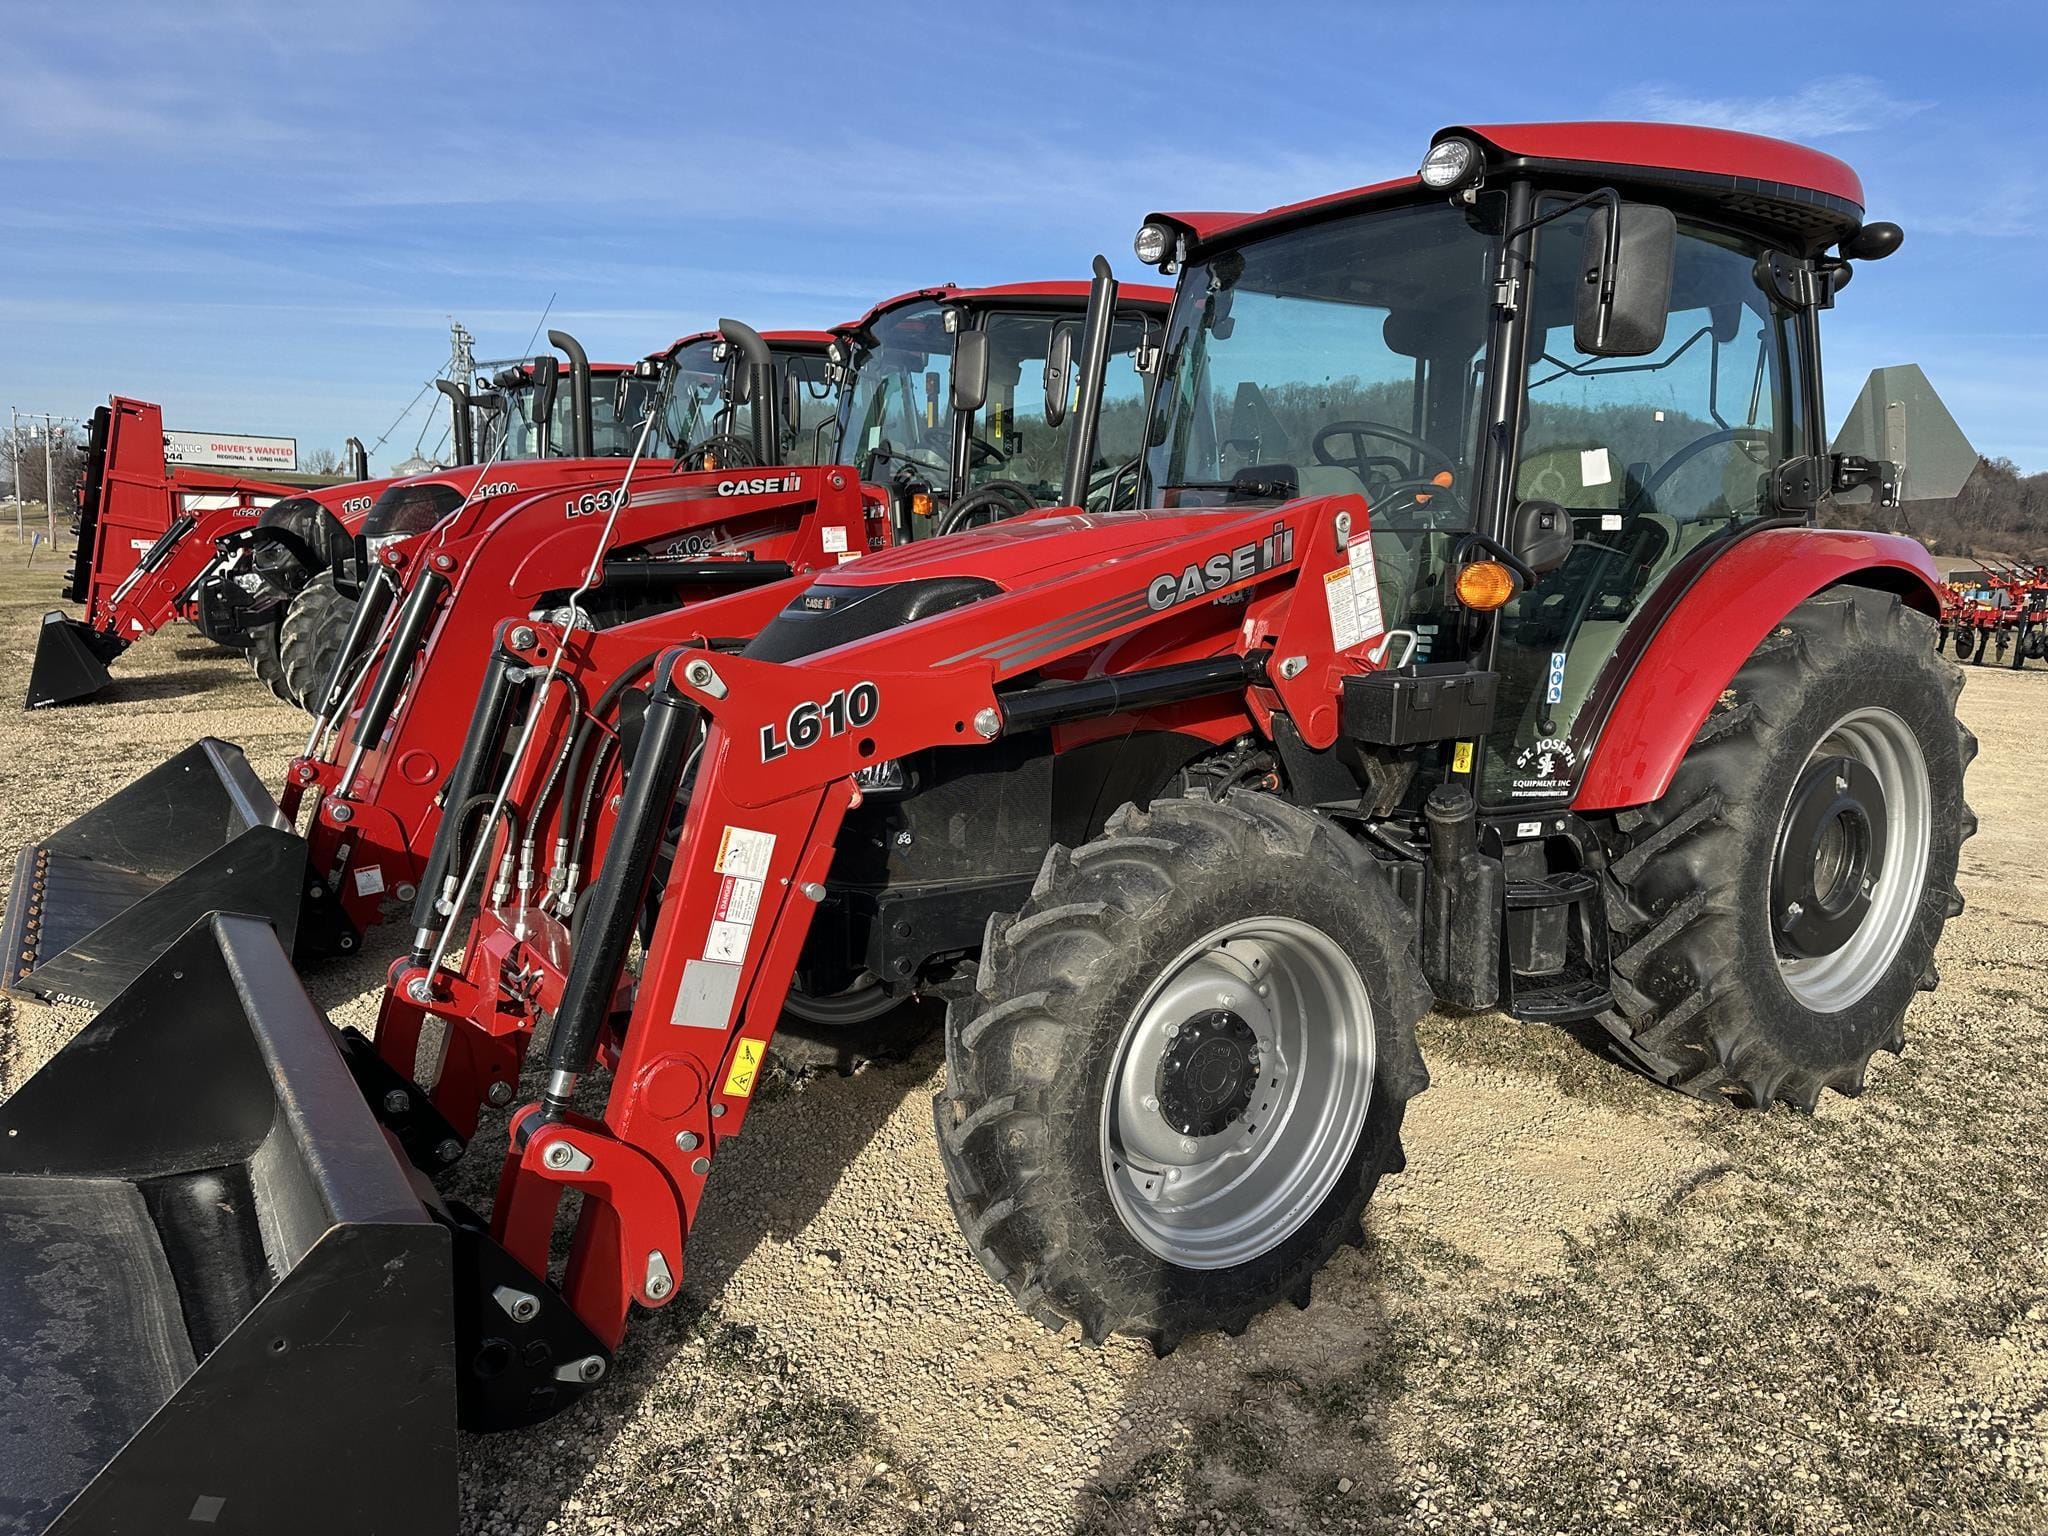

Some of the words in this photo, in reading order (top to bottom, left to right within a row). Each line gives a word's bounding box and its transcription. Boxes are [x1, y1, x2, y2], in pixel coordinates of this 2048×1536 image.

[210, 443, 253, 453] DRIVER'S
[254, 447, 293, 456] WANTED
[216, 453, 246, 461] REGIONAL
[717, 480, 780, 497] CASE
[342, 496, 372, 514] 150
[566, 487, 631, 519] L630
[233, 508, 263, 518] L620
[1148, 542, 1256, 612] CASE
[805, 598, 824, 609] CASE
[760, 681, 880, 764] L610
[1536, 739, 1576, 767] JOSEPH
[1512, 780, 1557, 788] EQUIPMENT
[720, 831, 732, 861] WARNING
[720, 878, 734, 910] DANGER
